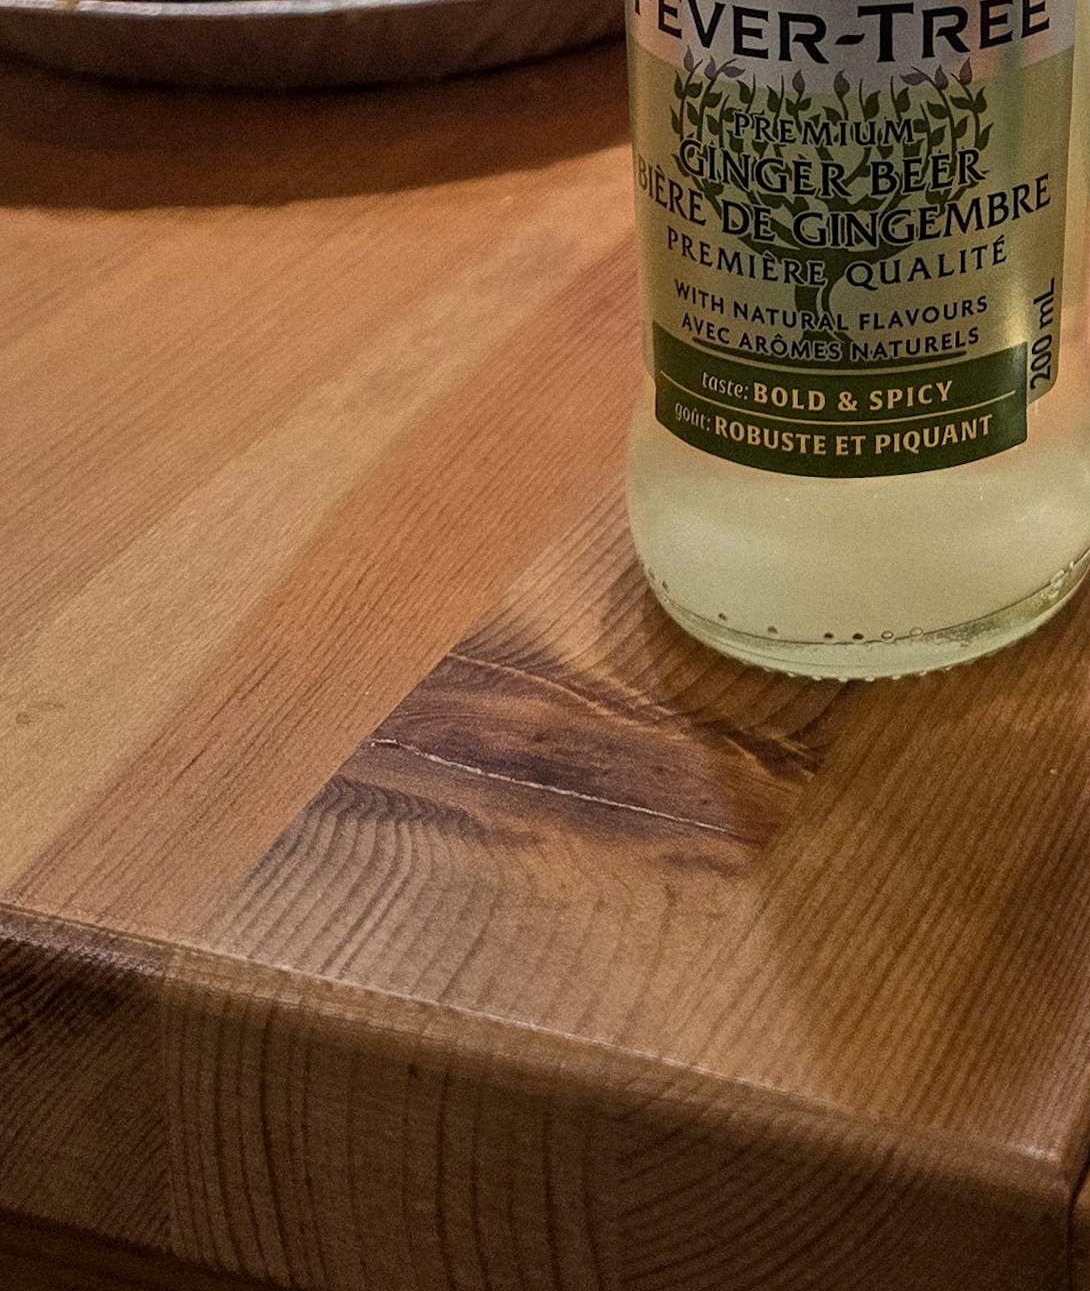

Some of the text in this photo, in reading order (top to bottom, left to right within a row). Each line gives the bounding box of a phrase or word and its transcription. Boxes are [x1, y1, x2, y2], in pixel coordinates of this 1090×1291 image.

[733, 111, 916, 147] PREMIUM
[679, 138, 986, 197] GINGER BEER
[638, 153, 1051, 248] BIÈRE DE GINGEMBRE
[667, 226, 1008, 291] PREMIÈRE QUALITÉ
[674, 278, 988, 331] WITH NATURAL FLAVOURS
[682, 313, 980, 361] AVEC ARÔMES NATURELS
[1030, 277, 1056, 390] 200 mL
[701, 372, 953, 412] taste: BOLD & SPICY
[674, 401, 993, 456] goût: ROBUSTE ET PIQUANT
